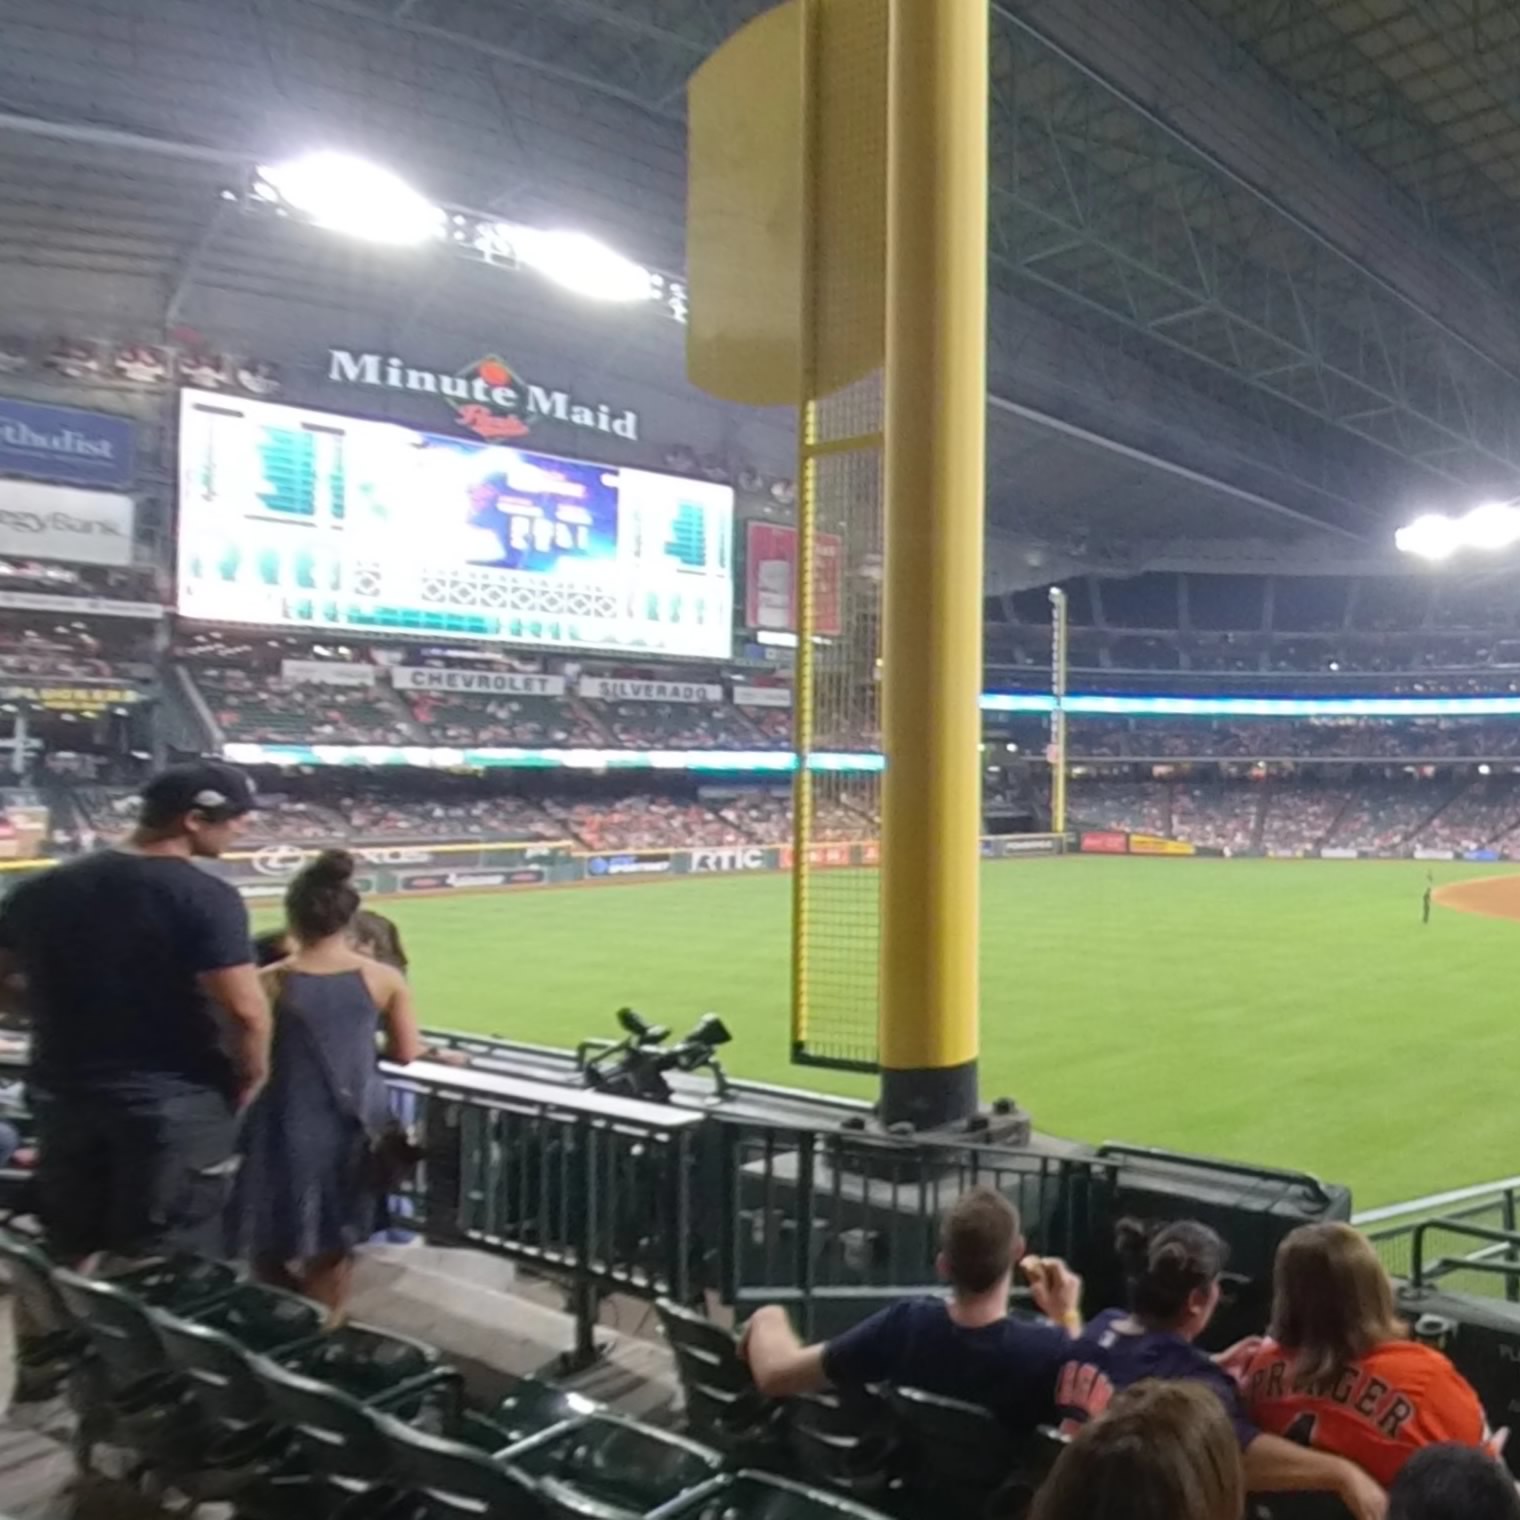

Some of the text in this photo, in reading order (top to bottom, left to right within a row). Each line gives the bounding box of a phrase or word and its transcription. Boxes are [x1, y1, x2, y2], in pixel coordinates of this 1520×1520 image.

[328, 350, 638, 440] Minute Maid
[410, 670, 551, 693] CHEVROLET
[599, 681, 709, 700] SILVERADO
[691, 849, 763, 872] RTIC
